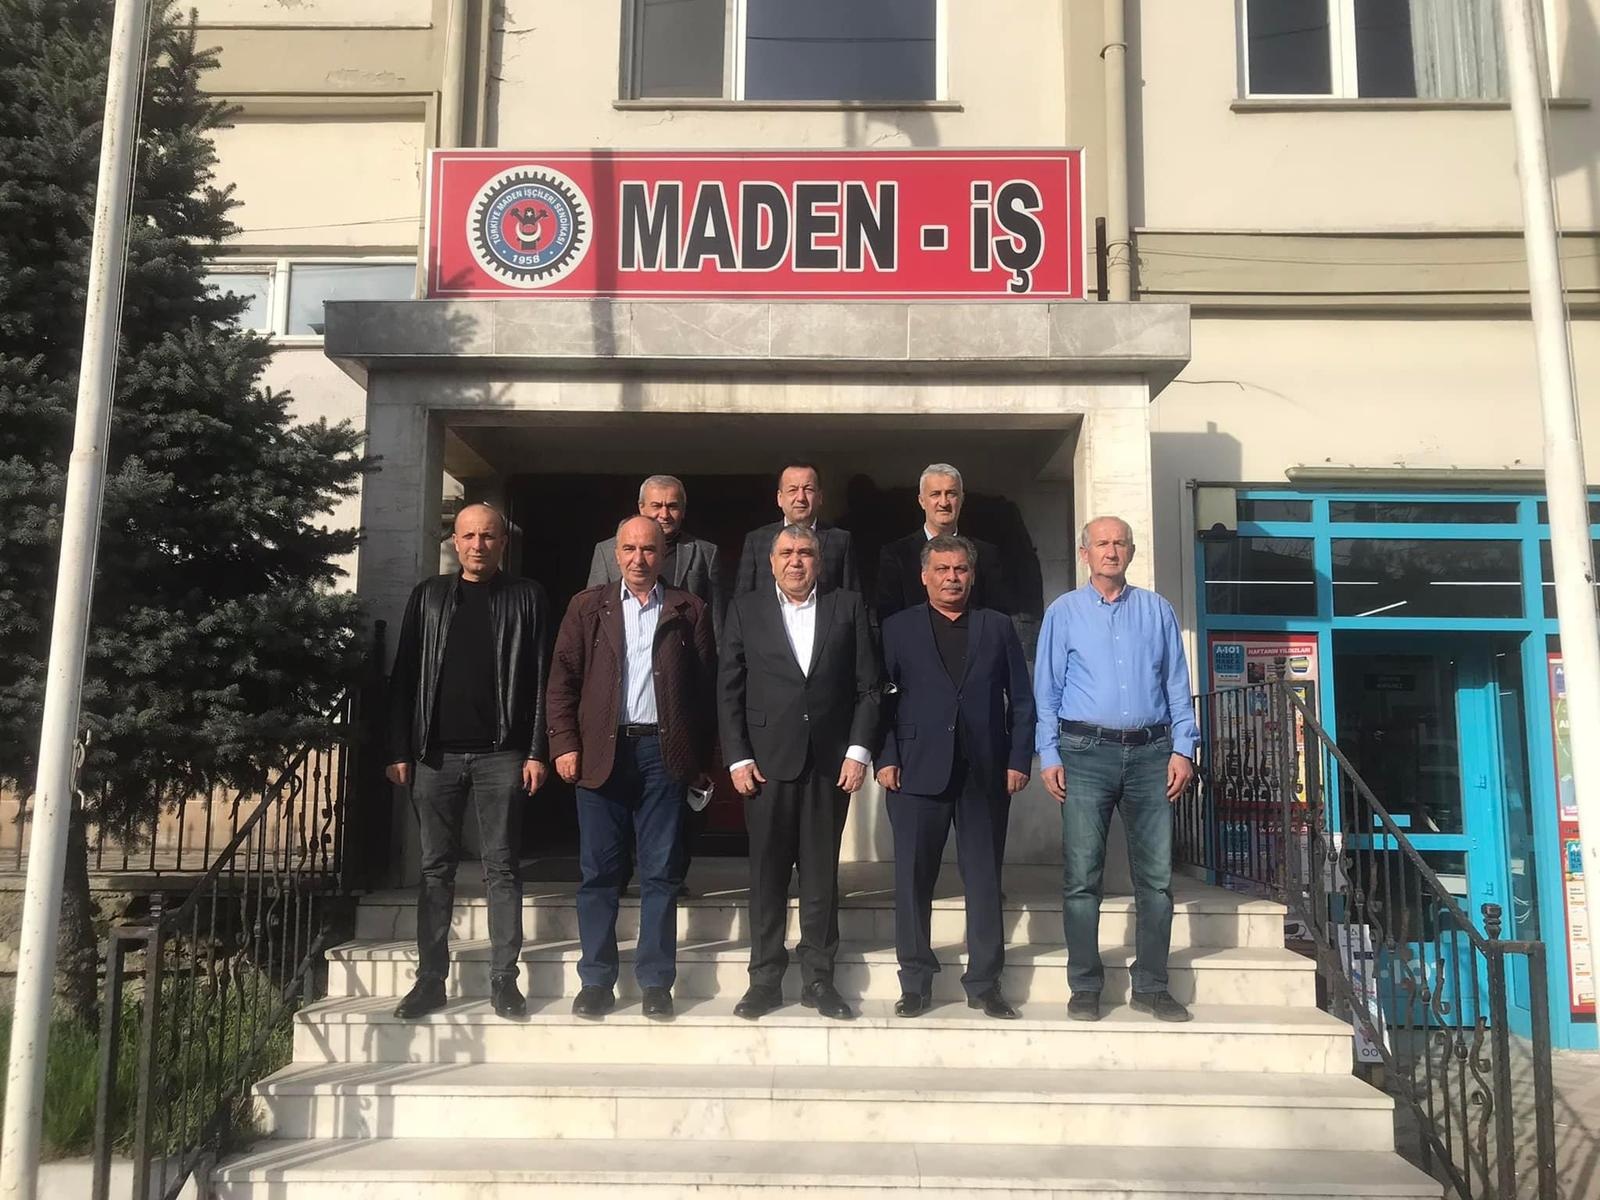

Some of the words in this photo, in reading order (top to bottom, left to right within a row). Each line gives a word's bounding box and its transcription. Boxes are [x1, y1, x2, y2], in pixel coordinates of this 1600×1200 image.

[489, 210, 501, 245] TÜRKİYE
[496, 190, 522, 212] MADEN
[524, 187, 557, 204] İŞÇİLERİ
[554, 203, 570, 246] SENDİKASI
[619, 182, 897, 271] MADEN
[921, 225, 948, 250] -
[512, 254, 540, 265] 1958
